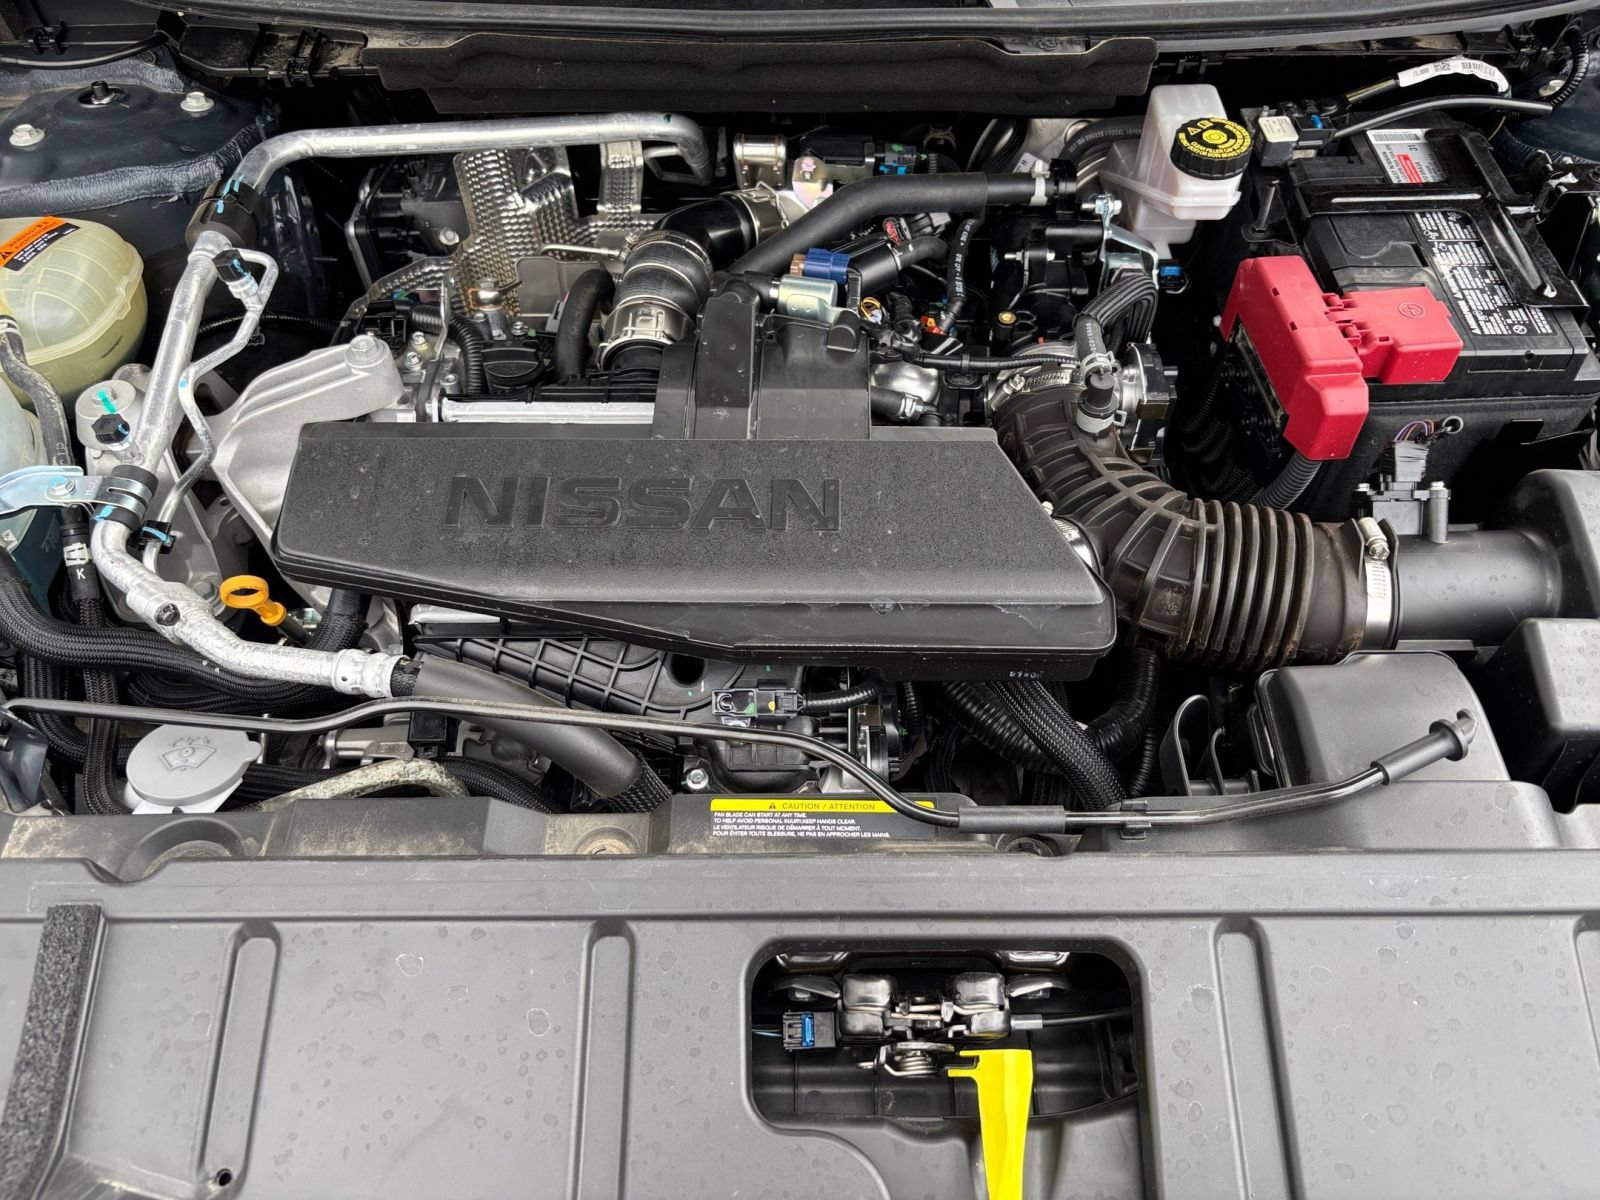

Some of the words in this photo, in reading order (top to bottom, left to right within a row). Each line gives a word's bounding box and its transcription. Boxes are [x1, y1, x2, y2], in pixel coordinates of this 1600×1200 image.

[443, 476, 841, 530] NISSAN
[76, 568, 86, 579] K
[782, 802, 820, 810] CAUTION
